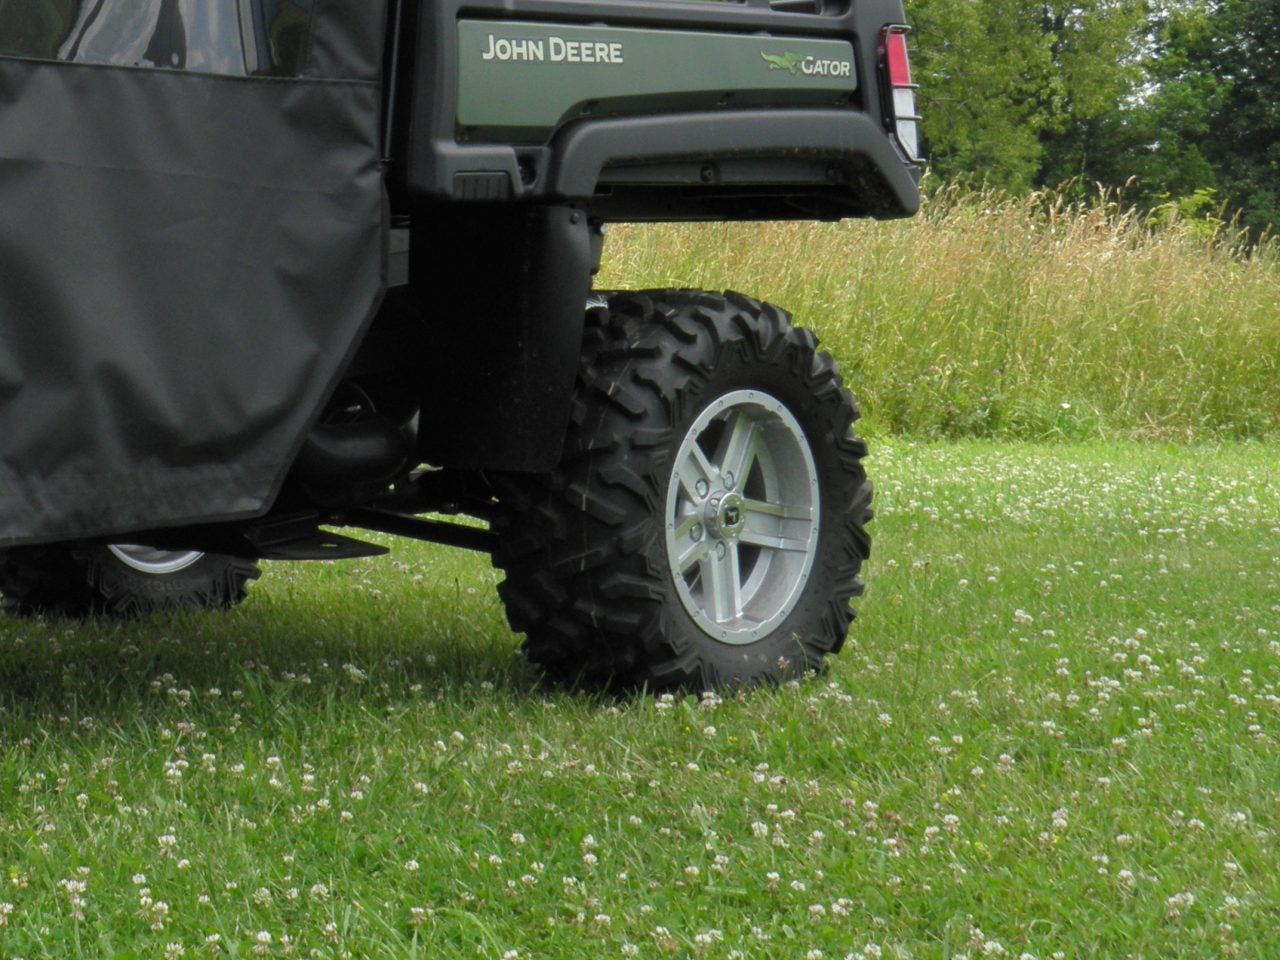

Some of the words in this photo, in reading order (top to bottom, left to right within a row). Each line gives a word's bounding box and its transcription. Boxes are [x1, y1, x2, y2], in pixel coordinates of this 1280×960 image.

[482, 34, 544, 61] JOHN
[548, 36, 624, 63] DEERE
[801, 55, 850, 76] GATOR
